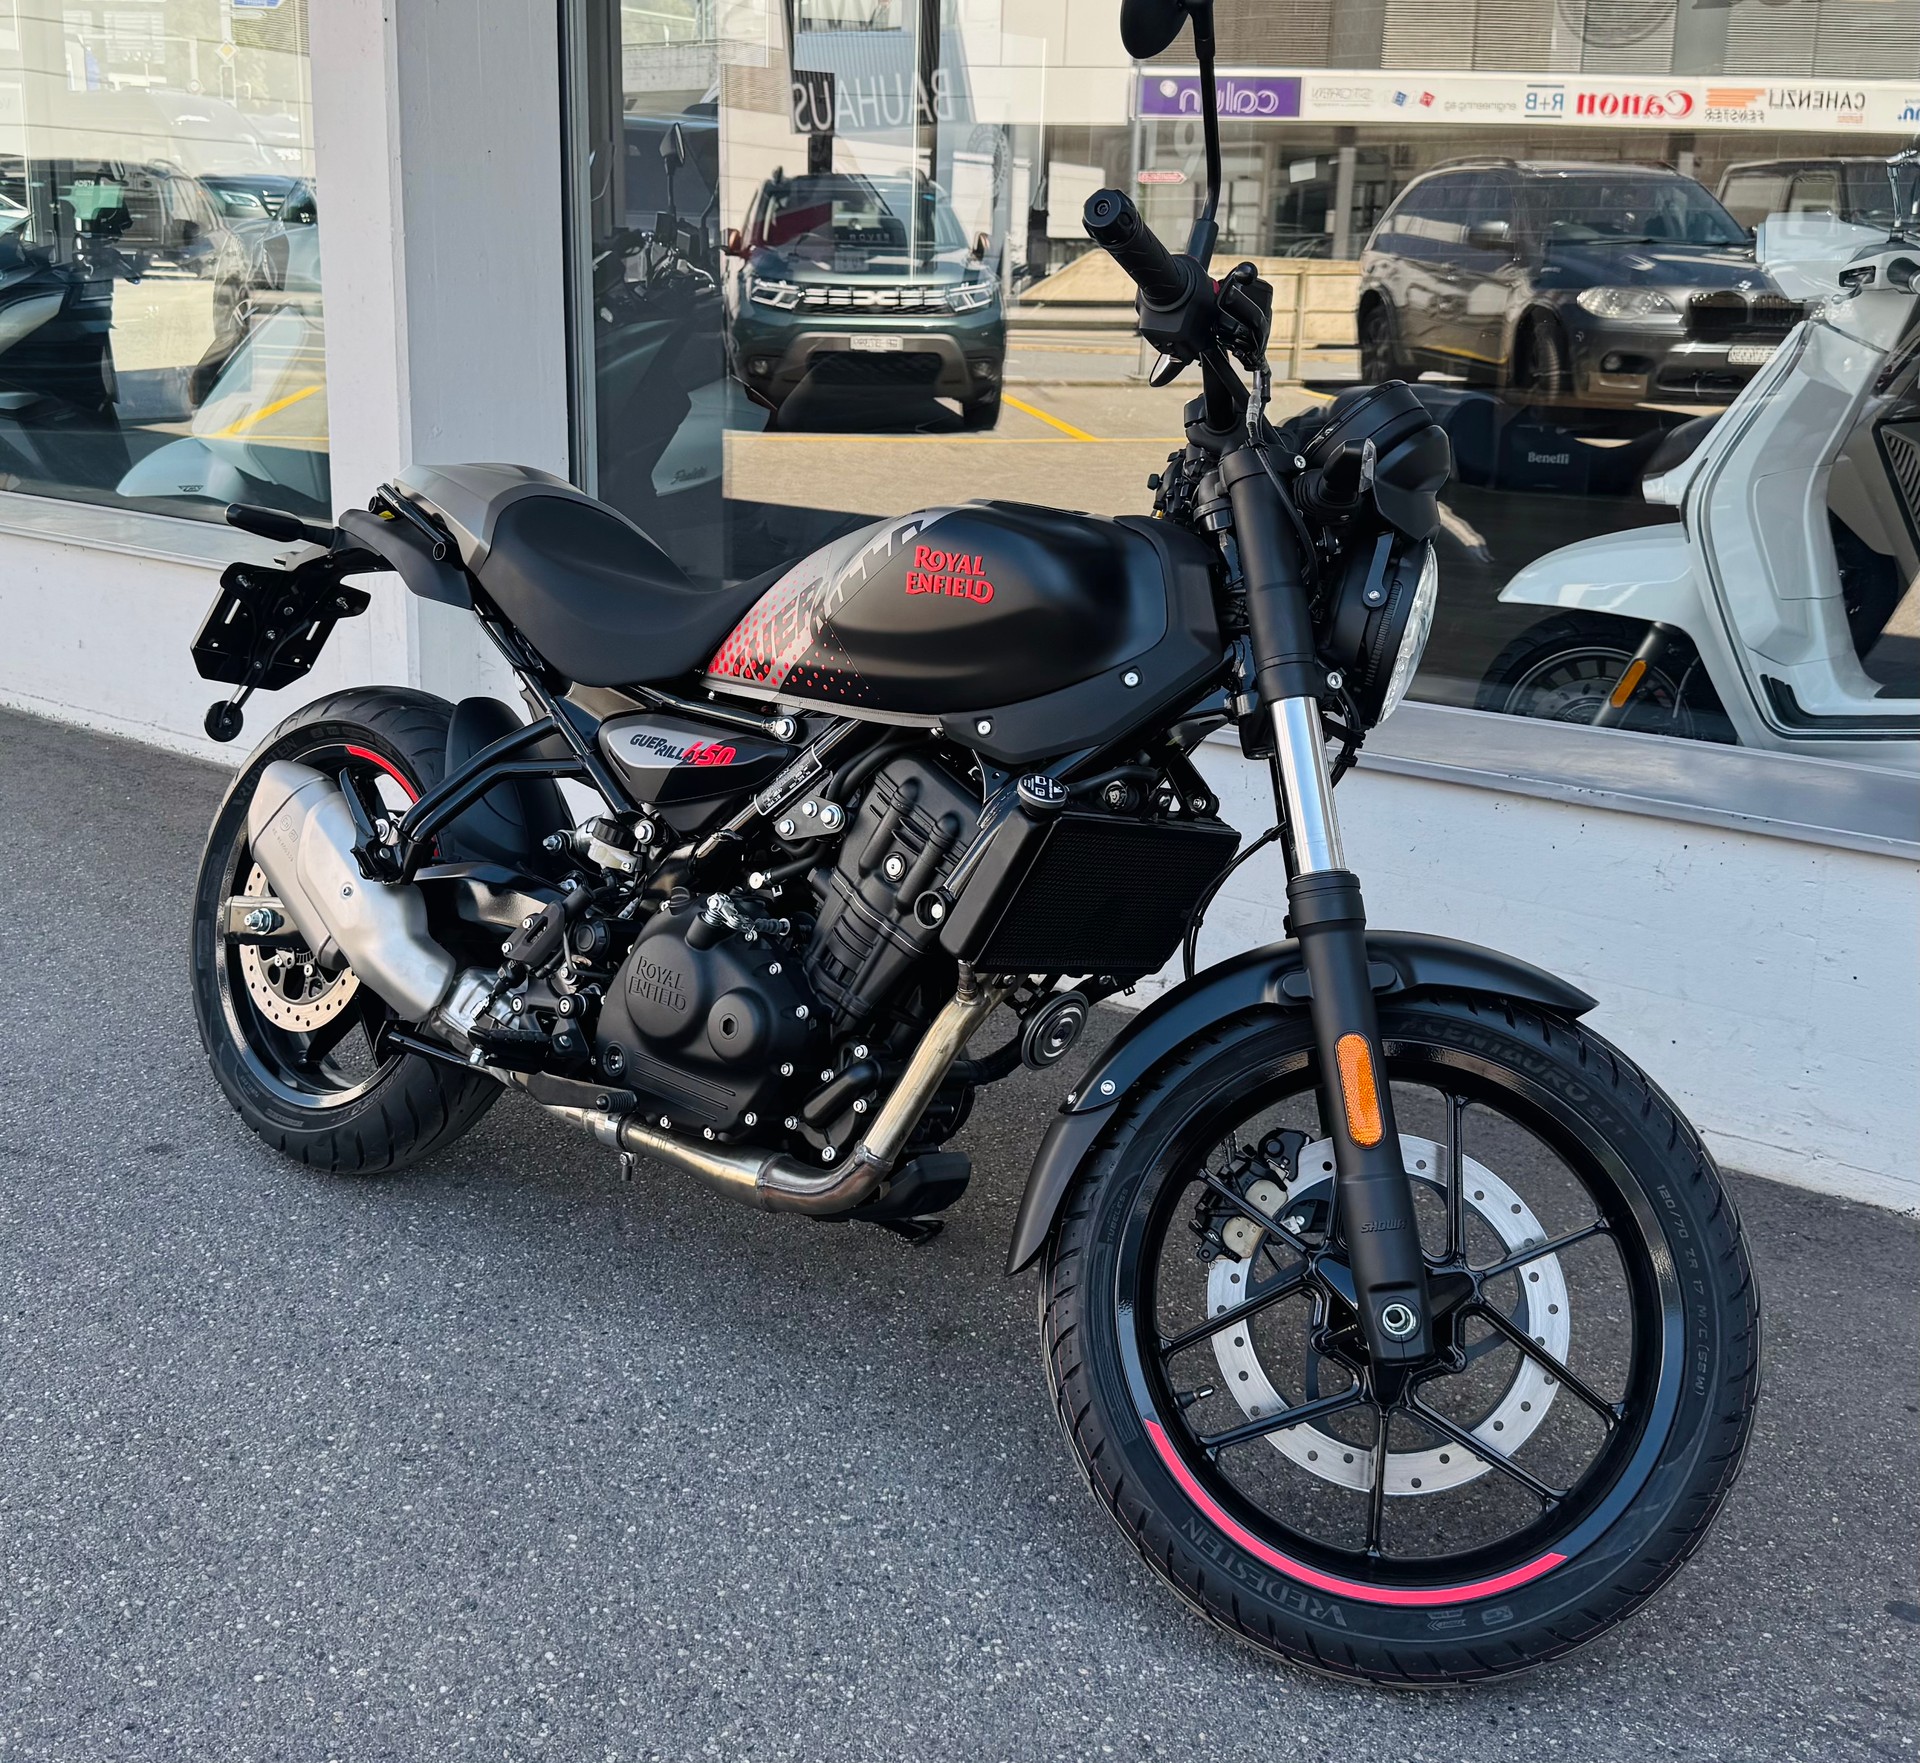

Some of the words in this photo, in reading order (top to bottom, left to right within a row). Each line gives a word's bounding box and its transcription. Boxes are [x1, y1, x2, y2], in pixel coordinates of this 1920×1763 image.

[1528, 452, 1570, 465] Benelli
[913, 544, 987, 577] ROYAL
[905, 570, 995, 604] ENFIELD
[681, 741, 737, 765] 450
[636, 955, 685, 992] ROYAL
[628, 975, 688, 1014] ENFIELD
[1360, 1218, 1409, 1234] SHOWA
[1657, 1184, 1690, 1240] 120/70
[1684, 1247, 1698, 1270] ZR
[1693, 1279, 1704, 1295] 17
[1696, 1303, 1709, 1340] M/C
[1181, 1515, 1349, 1628] VREDESTEIN
